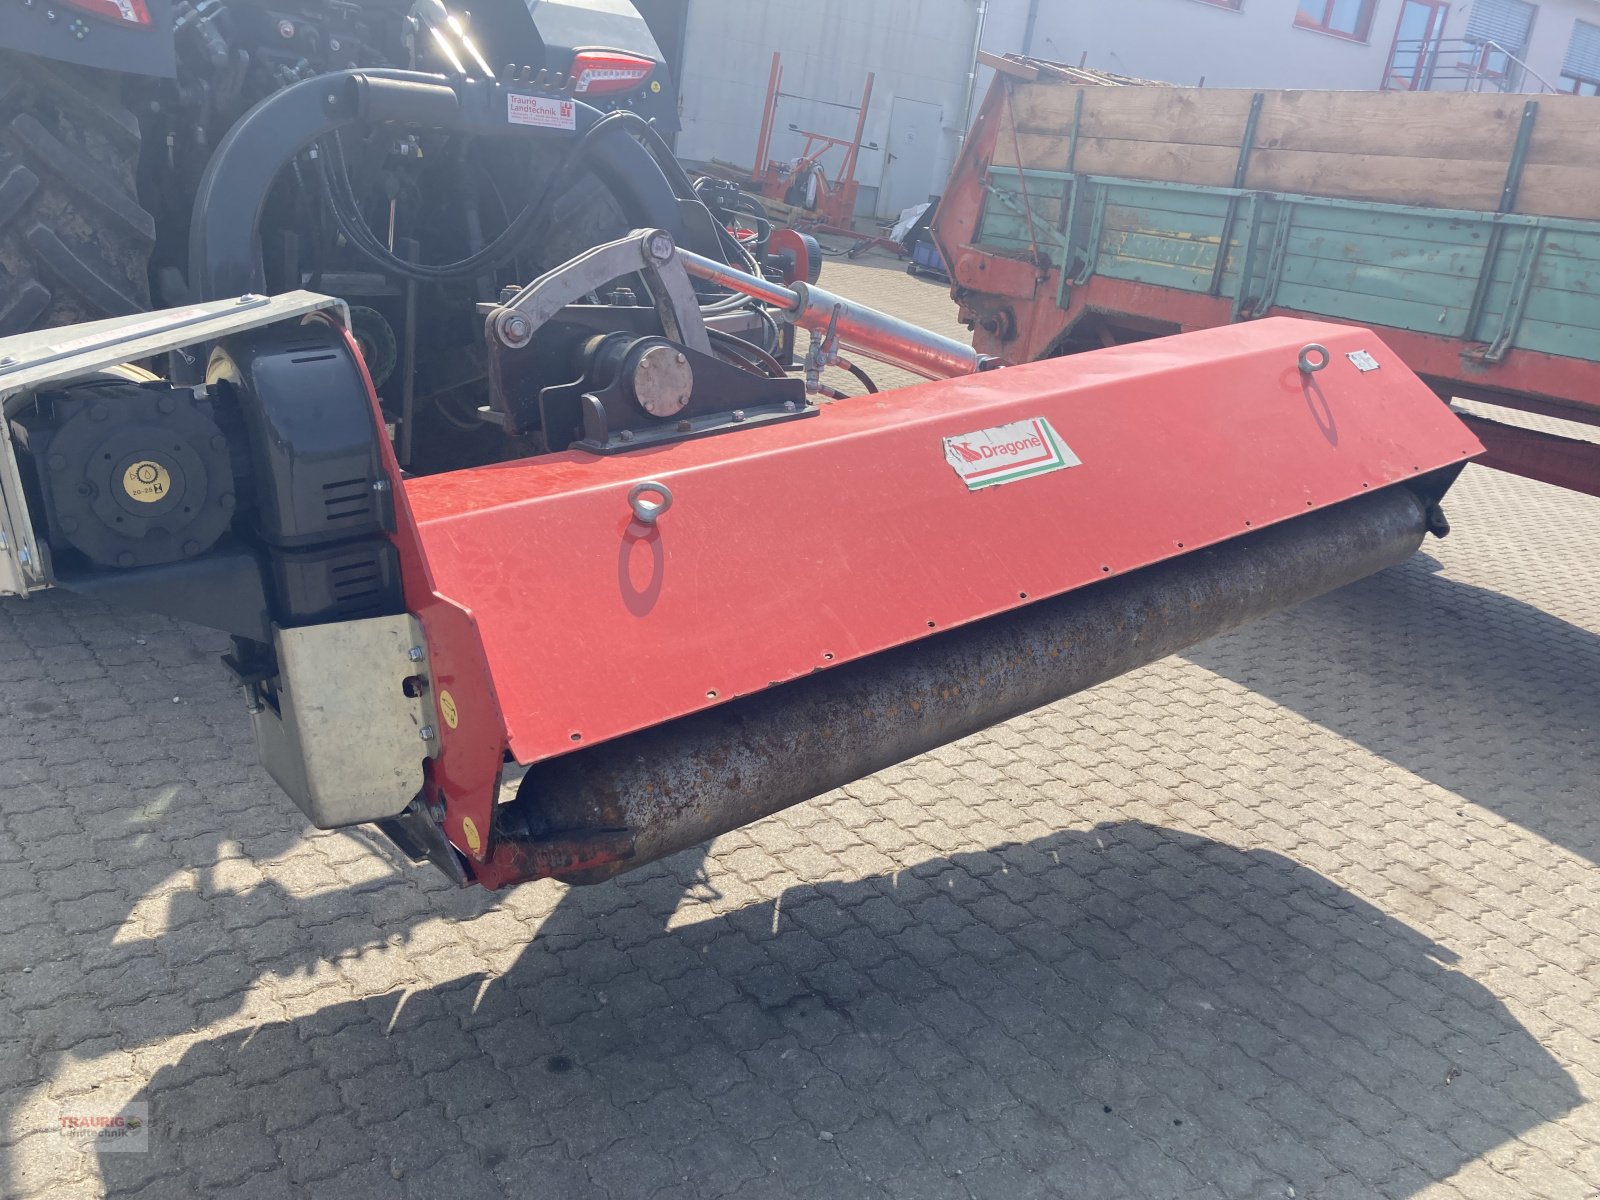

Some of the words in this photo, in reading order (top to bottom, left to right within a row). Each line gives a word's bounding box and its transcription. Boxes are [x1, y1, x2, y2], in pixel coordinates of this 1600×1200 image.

[510, 95, 537, 107] Traurig
[510, 103, 557, 116] Landtechnik
[980, 436, 1042, 459] Dragone
